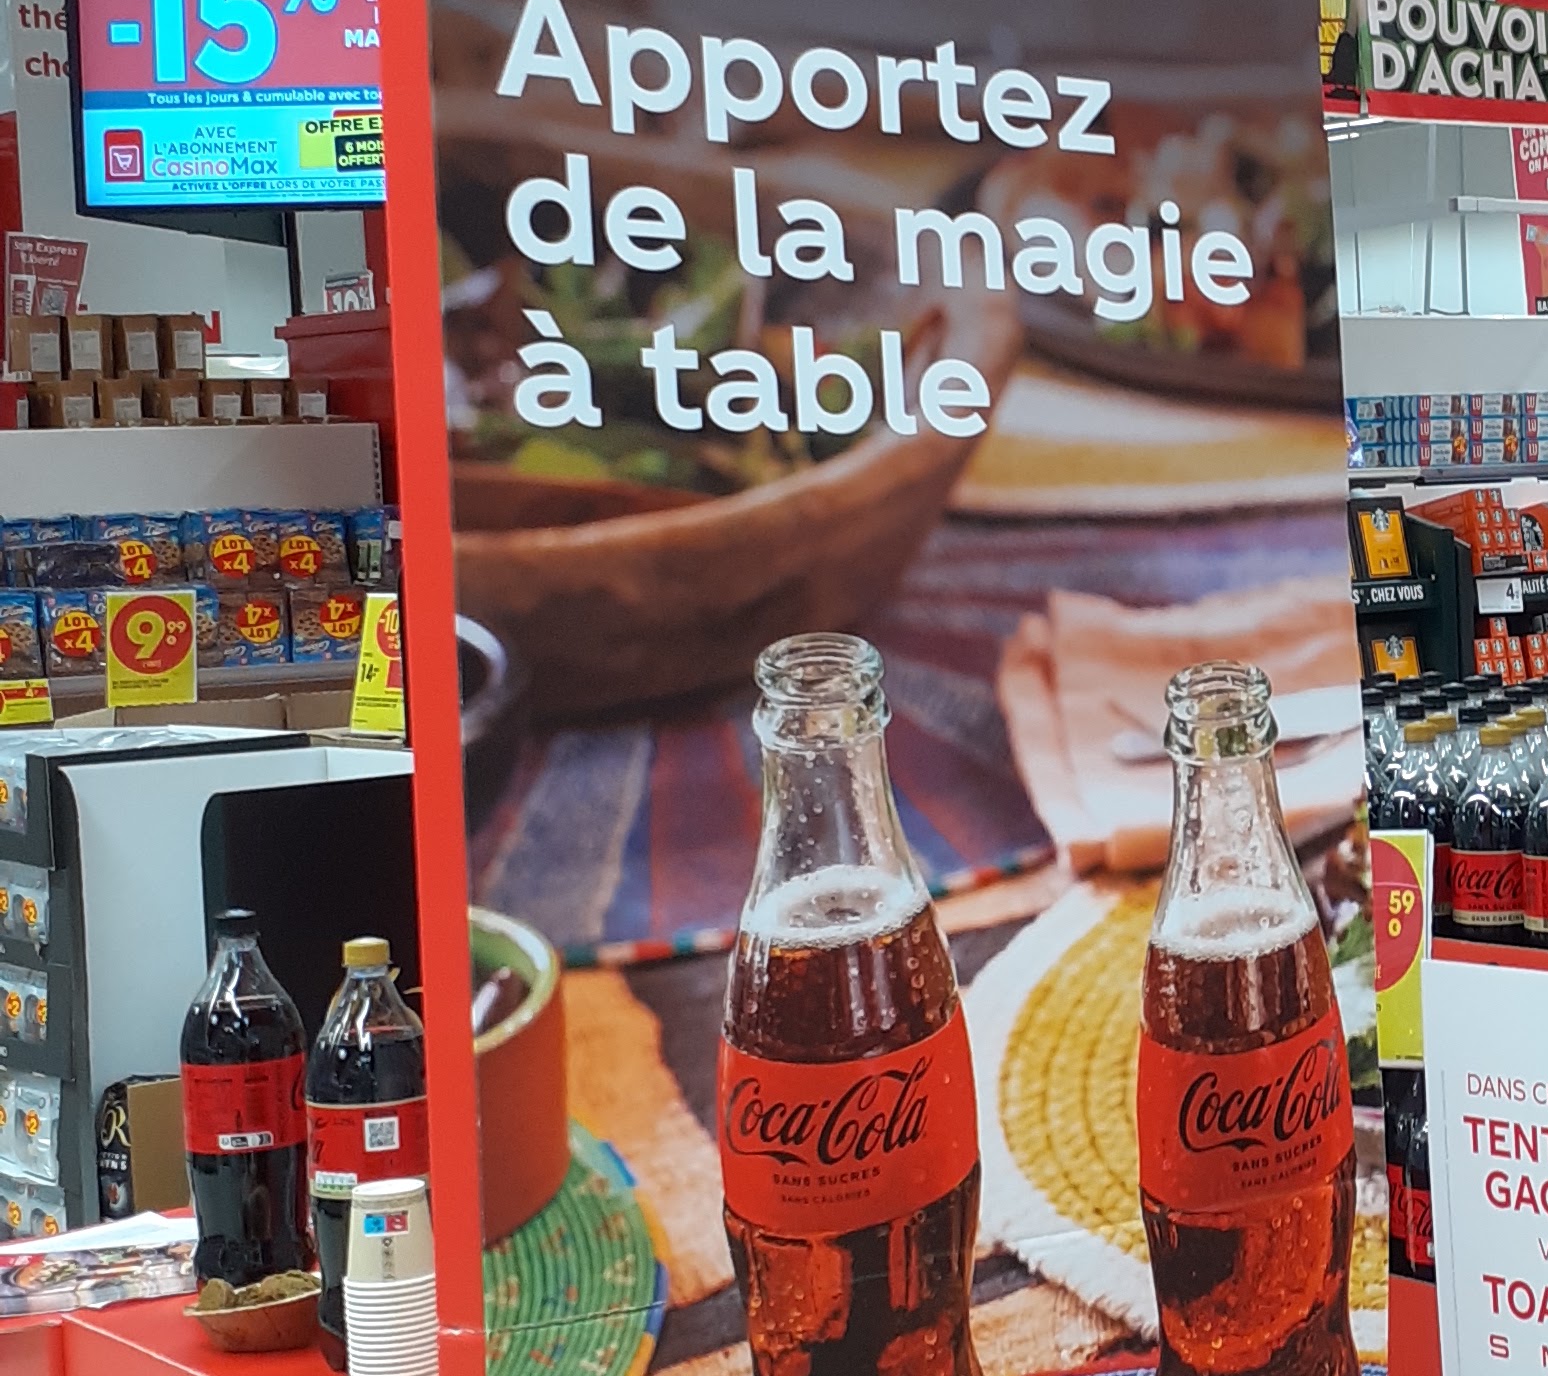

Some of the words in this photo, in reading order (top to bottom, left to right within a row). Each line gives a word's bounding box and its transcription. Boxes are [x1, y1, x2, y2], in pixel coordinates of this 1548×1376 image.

[148, 92, 179, 105] Tous
[183, 92, 202, 104] les
[206, 92, 240, 106] jours
[242, 91, 253, 102] &
[256, 89, 325, 102] cumulable
[328, 91, 361, 101] avec
[194, 127, 236, 138] AVEC
[154, 141, 278, 154] L'ABONNEMENT
[152, 157, 278, 176] CasinoMax
[1529, 158, 1541, 174] ON
[1543, 156, 1548, 170] A
[505, 153, 686, 272] de
[732, 167, 854, 282] la
[895, 200, 1254, 323] magie
[513, 308, 602, 428] à
[640, 323, 992, 439] table
[222, 540, 245, 550] LOT
[289, 540, 312, 550] LOT
[223, 554, 250, 573] x4
[289, 553, 317, 574] x4
[1371, 588, 1396, 603] CHEZ
[1398, 584, 1424, 600] VOUS
[64, 616, 91, 626] LOT
[64, 631, 94, 652] x4
[1388, 890, 1415, 915] 59
[1466, 1072, 1526, 1102] DANS
[725, 1058, 936, 1167] Coca-Cola
[1231, 1158, 1269, 1173] SANS
[772, 1171, 810, 1187] SANS
[816, 1165, 882, 1185] SUCRES
